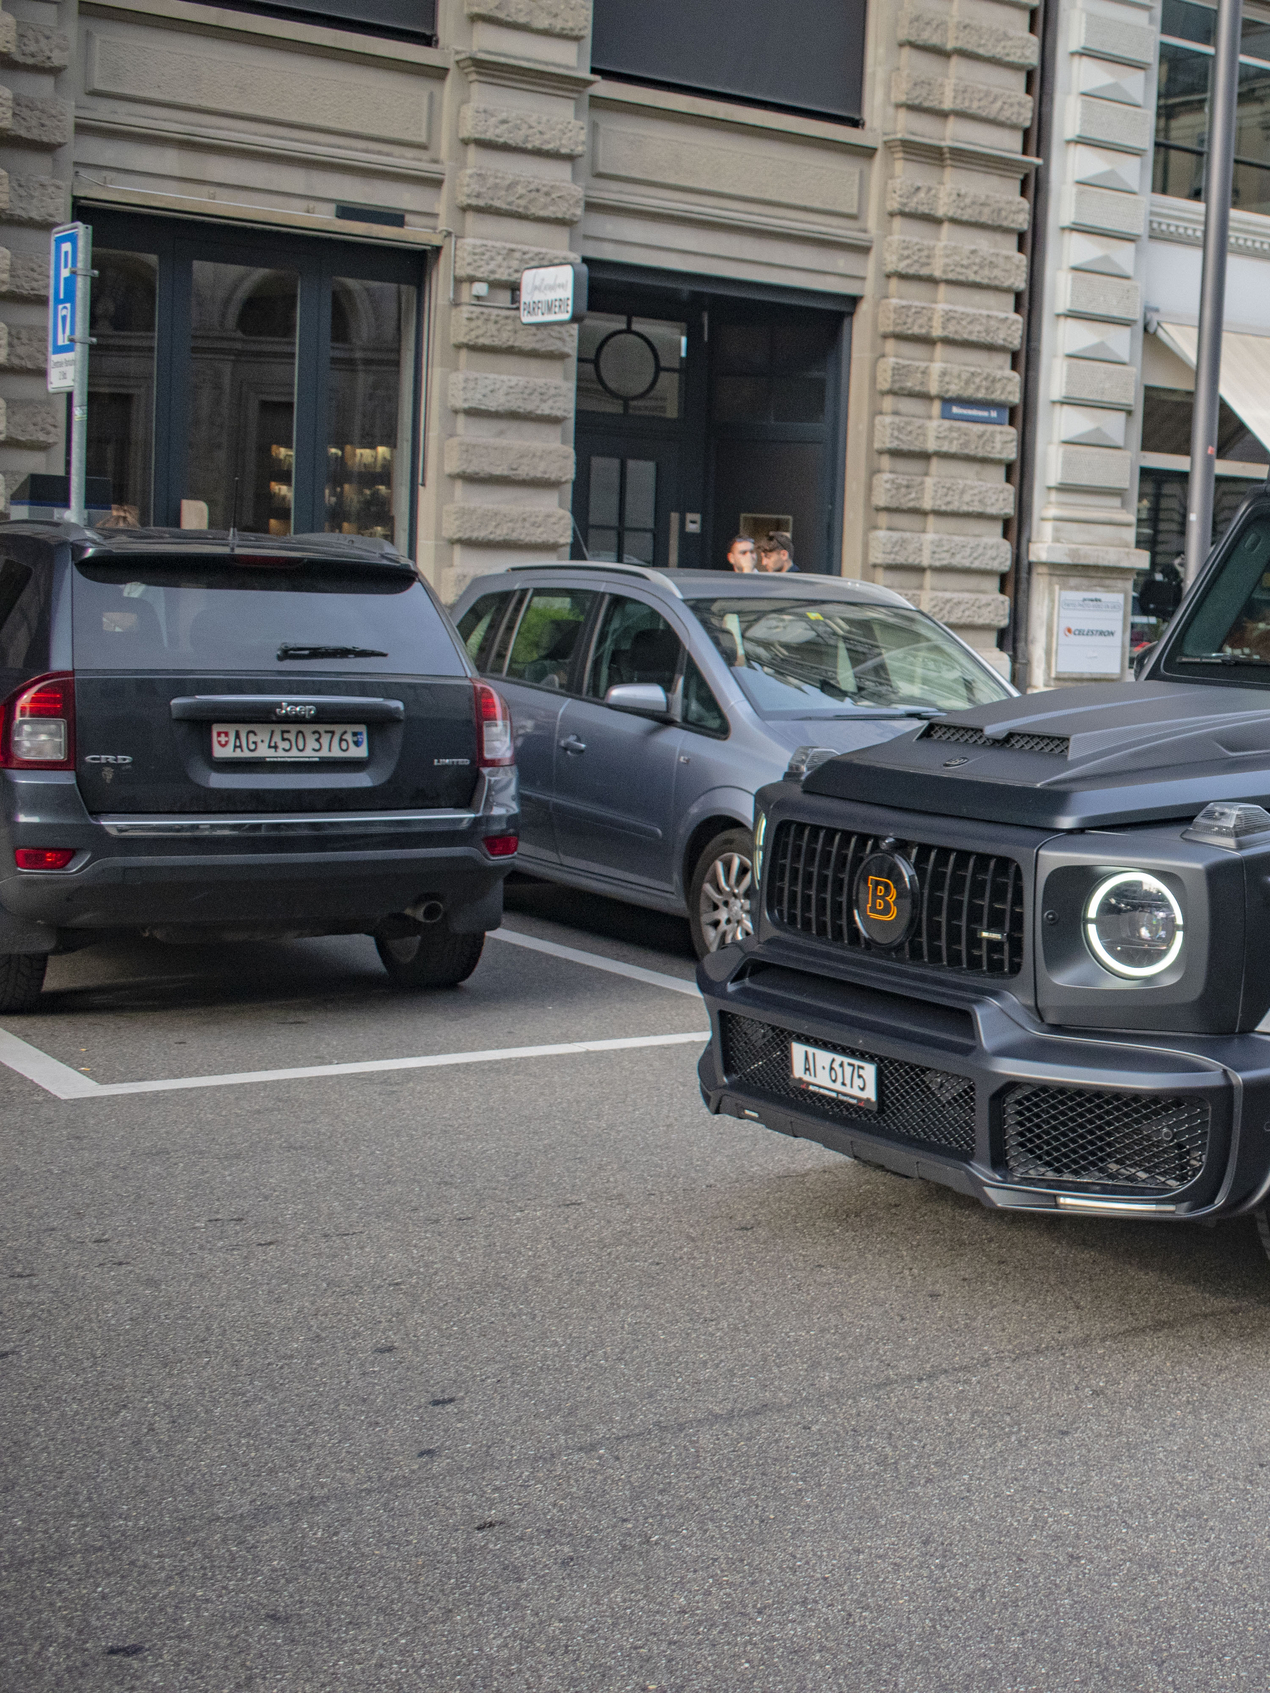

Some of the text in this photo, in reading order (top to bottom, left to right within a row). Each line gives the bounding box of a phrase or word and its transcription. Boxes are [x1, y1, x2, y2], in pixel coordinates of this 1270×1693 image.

[522, 297, 570, 318] PARFUMERIE
[1072, 628, 1117, 638] CELESTRON
[275, 702, 317, 719] Jeep
[84, 754, 134, 764] CRD
[433, 758, 471, 766] LIMITED
[866, 875, 898, 922] B
